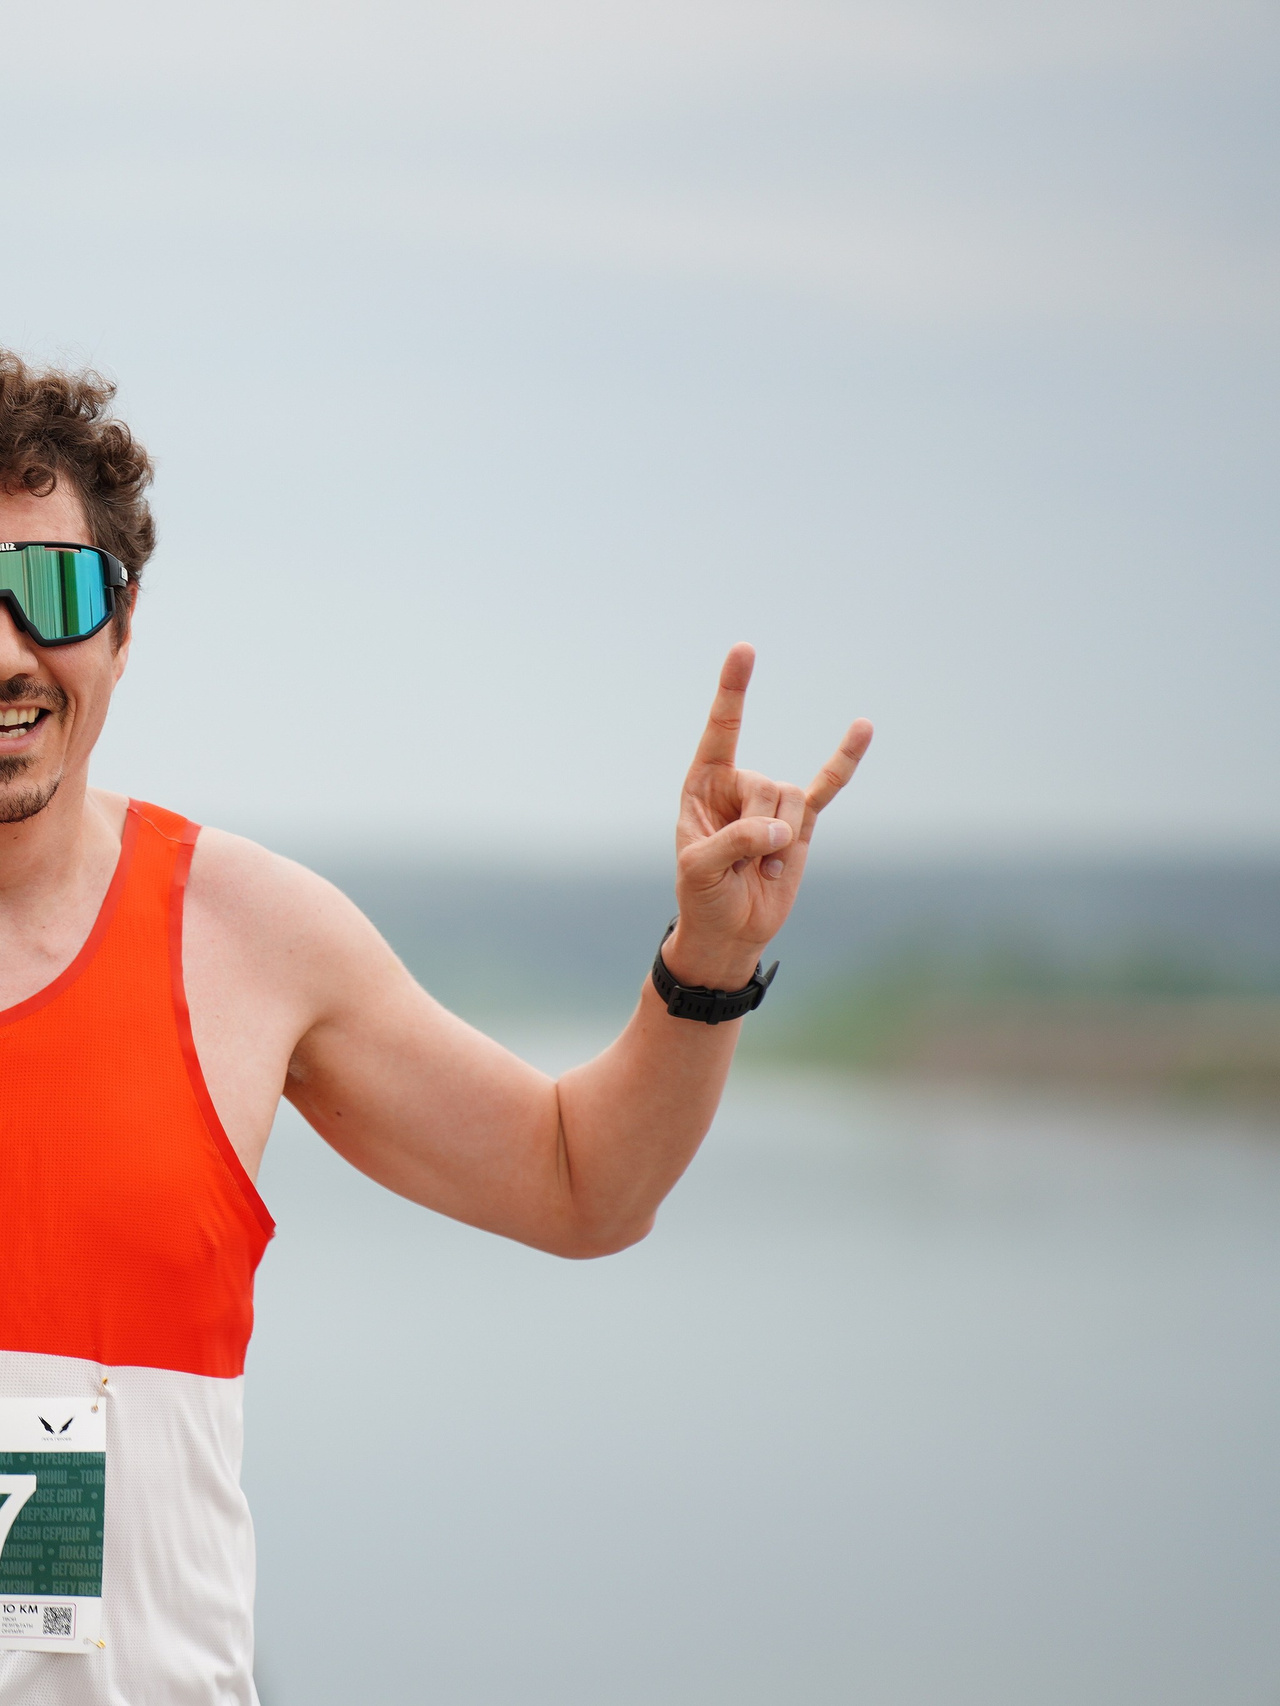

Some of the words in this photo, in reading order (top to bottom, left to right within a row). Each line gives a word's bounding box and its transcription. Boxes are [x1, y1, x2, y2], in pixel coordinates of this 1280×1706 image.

[56, 1489, 84, 1504] СПЯТ
[20, 1507, 97, 1522] ПЕРЕЗАГРУЗКА
[12, 1526, 41, 1541] ВСЕМ
[42, 1526, 90, 1543] СЕРДЦЕМ
[58, 1545, 87, 1560] ПОКА
[51, 1563, 97, 1578] БЕГОВАЯ
[52, 1580, 77, 1595] БЕГУ
[3, 1604, 16, 1614] 10
